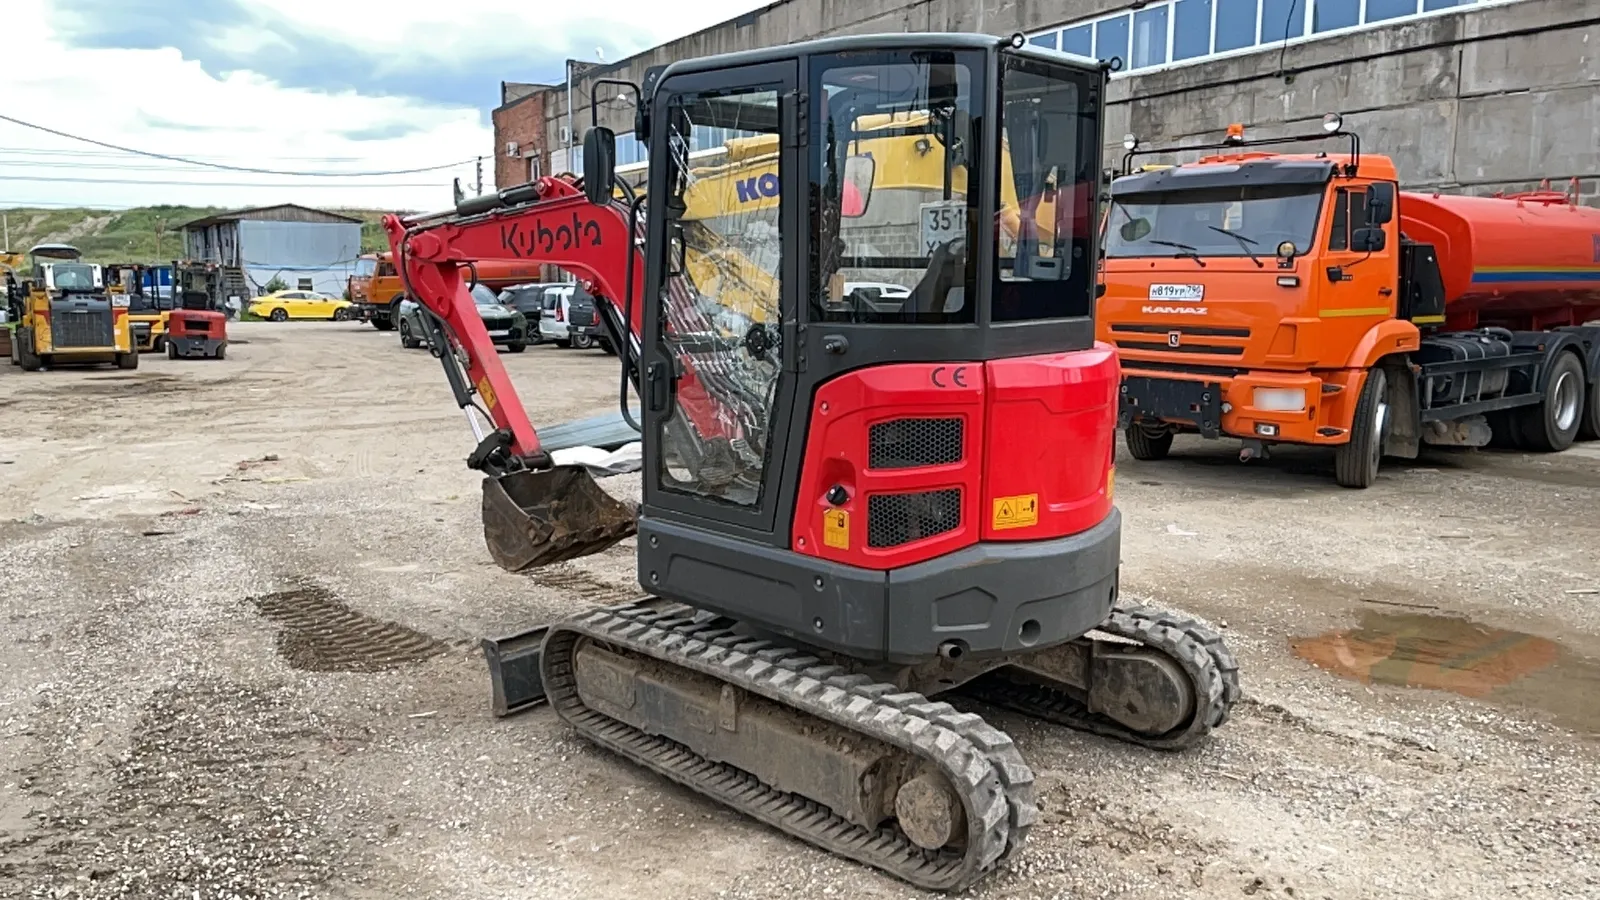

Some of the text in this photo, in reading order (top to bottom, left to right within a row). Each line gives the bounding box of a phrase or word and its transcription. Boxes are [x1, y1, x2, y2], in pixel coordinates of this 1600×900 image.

[929, 208, 966, 231] 351
[500, 211, 602, 257] Kubota
[1141, 305, 1208, 315] KAMAZ
